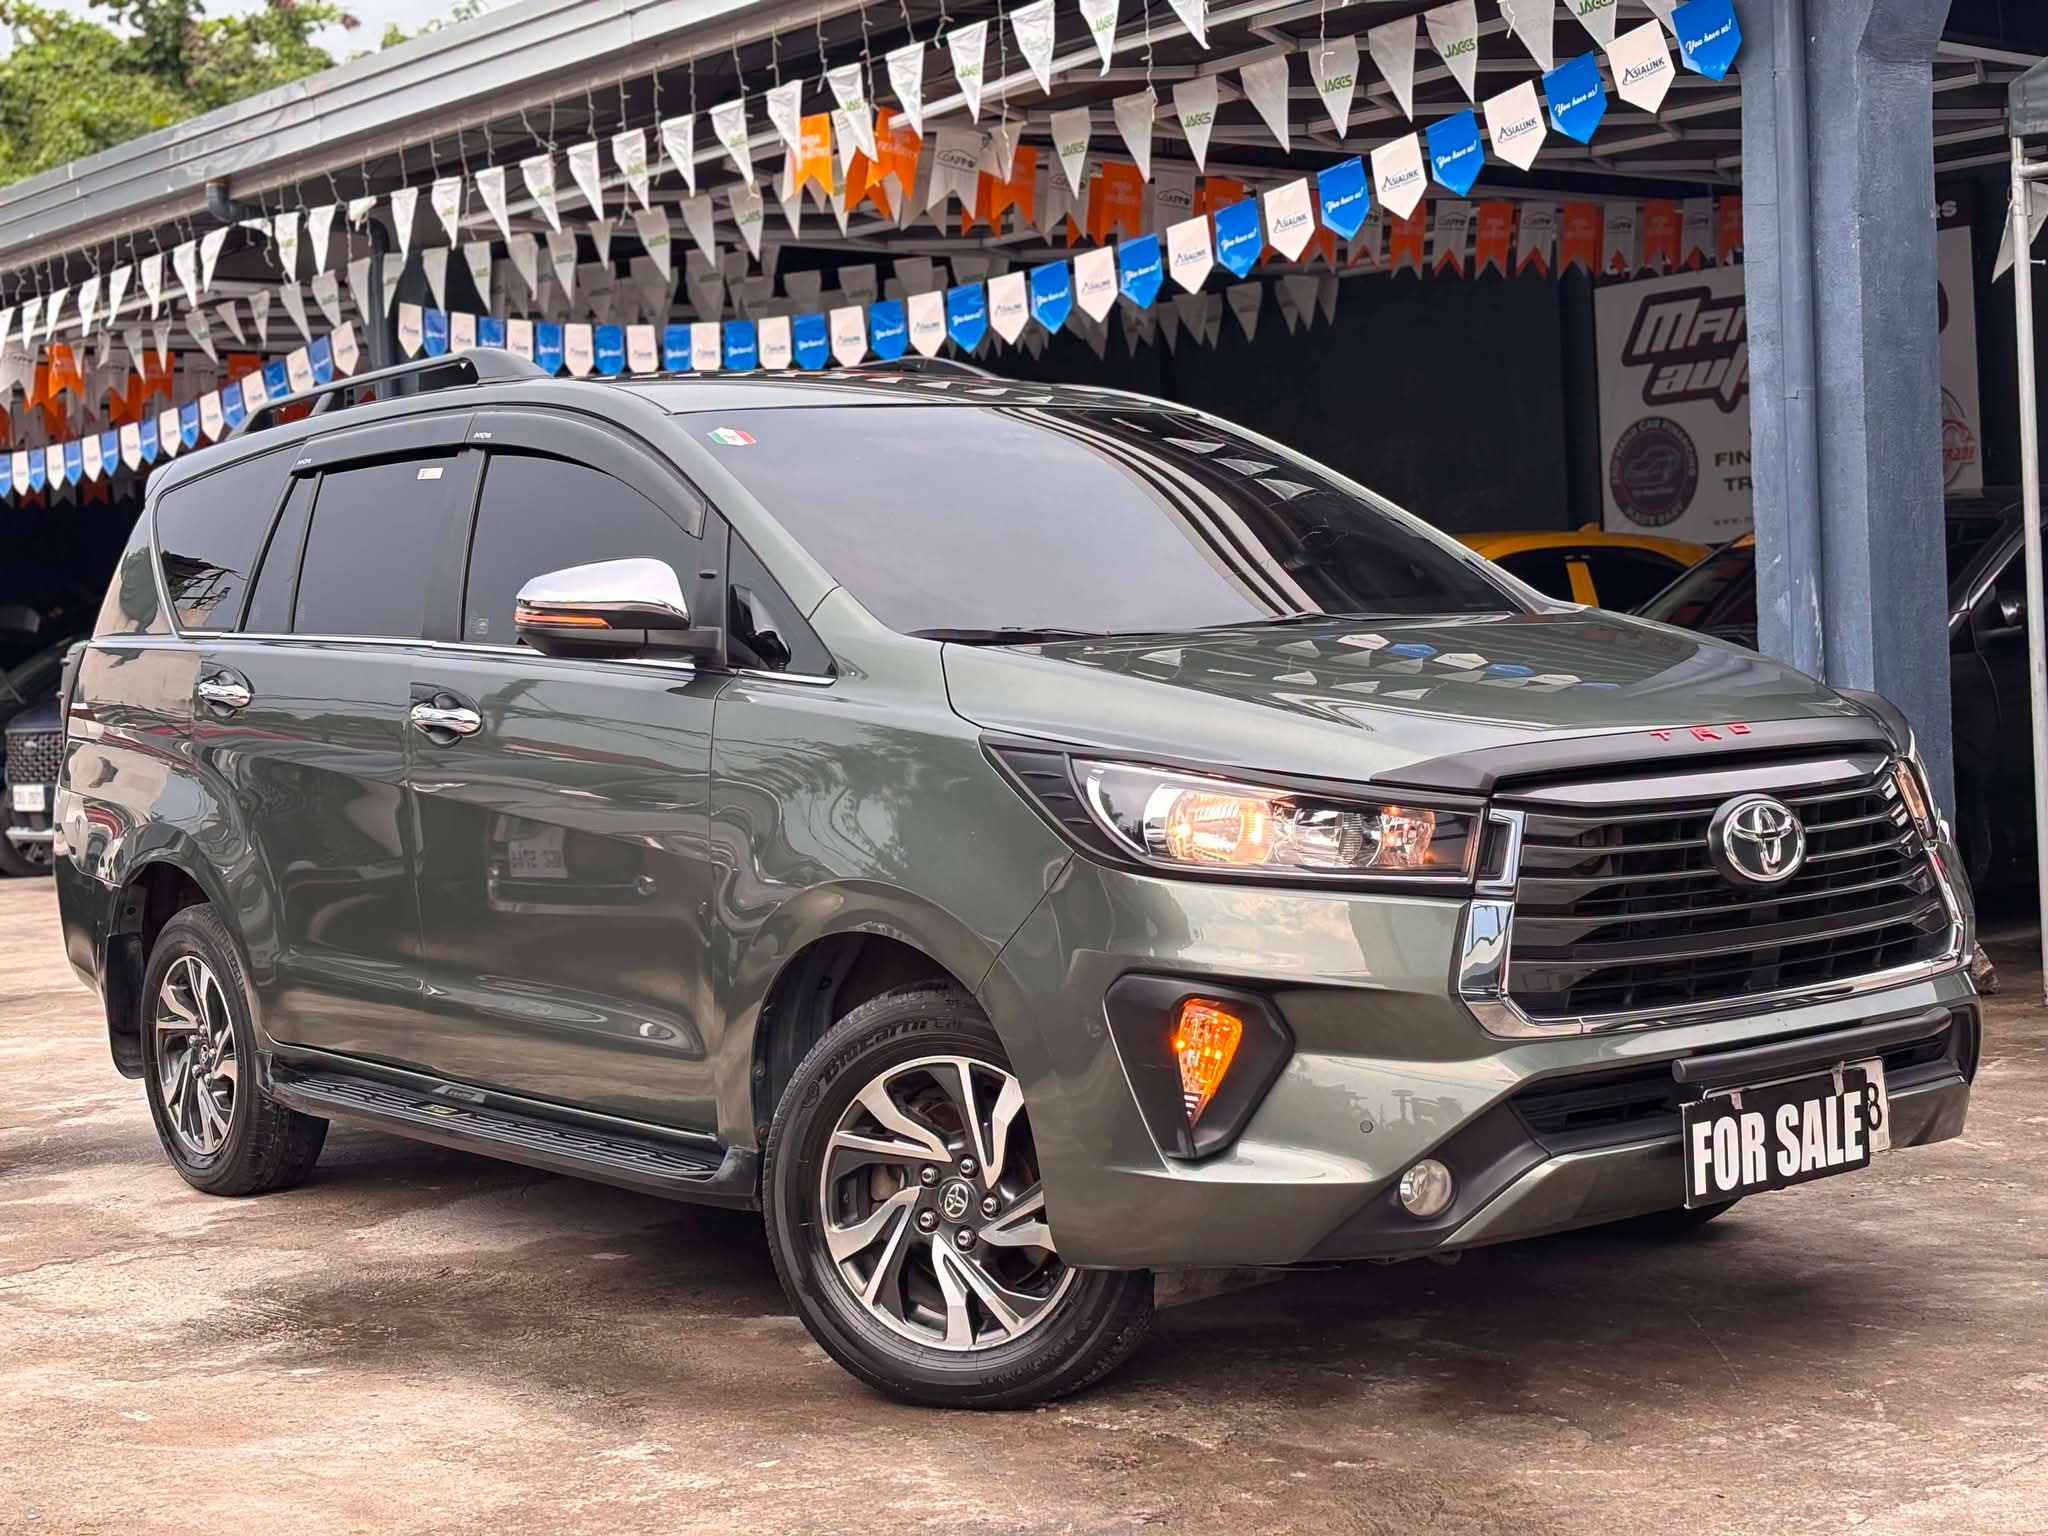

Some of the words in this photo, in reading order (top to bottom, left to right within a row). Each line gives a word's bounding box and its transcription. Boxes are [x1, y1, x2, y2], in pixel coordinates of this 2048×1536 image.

[1685, 39, 1703, 55] You
[1704, 29, 1720, 45] have
[1721, 18, 1731, 34] us!
[1624, 57, 1665, 82] ASIALINK
[1555, 102, 1571, 117] You
[1571, 93, 1587, 109] have
[1588, 83, 1598, 98] us!
[1499, 116, 1537, 140] ASIALINK
[1650, 722, 1752, 741] TRD
[1692, 1112, 1767, 1196] FOR
[1776, 1091, 1863, 1177] SALE
